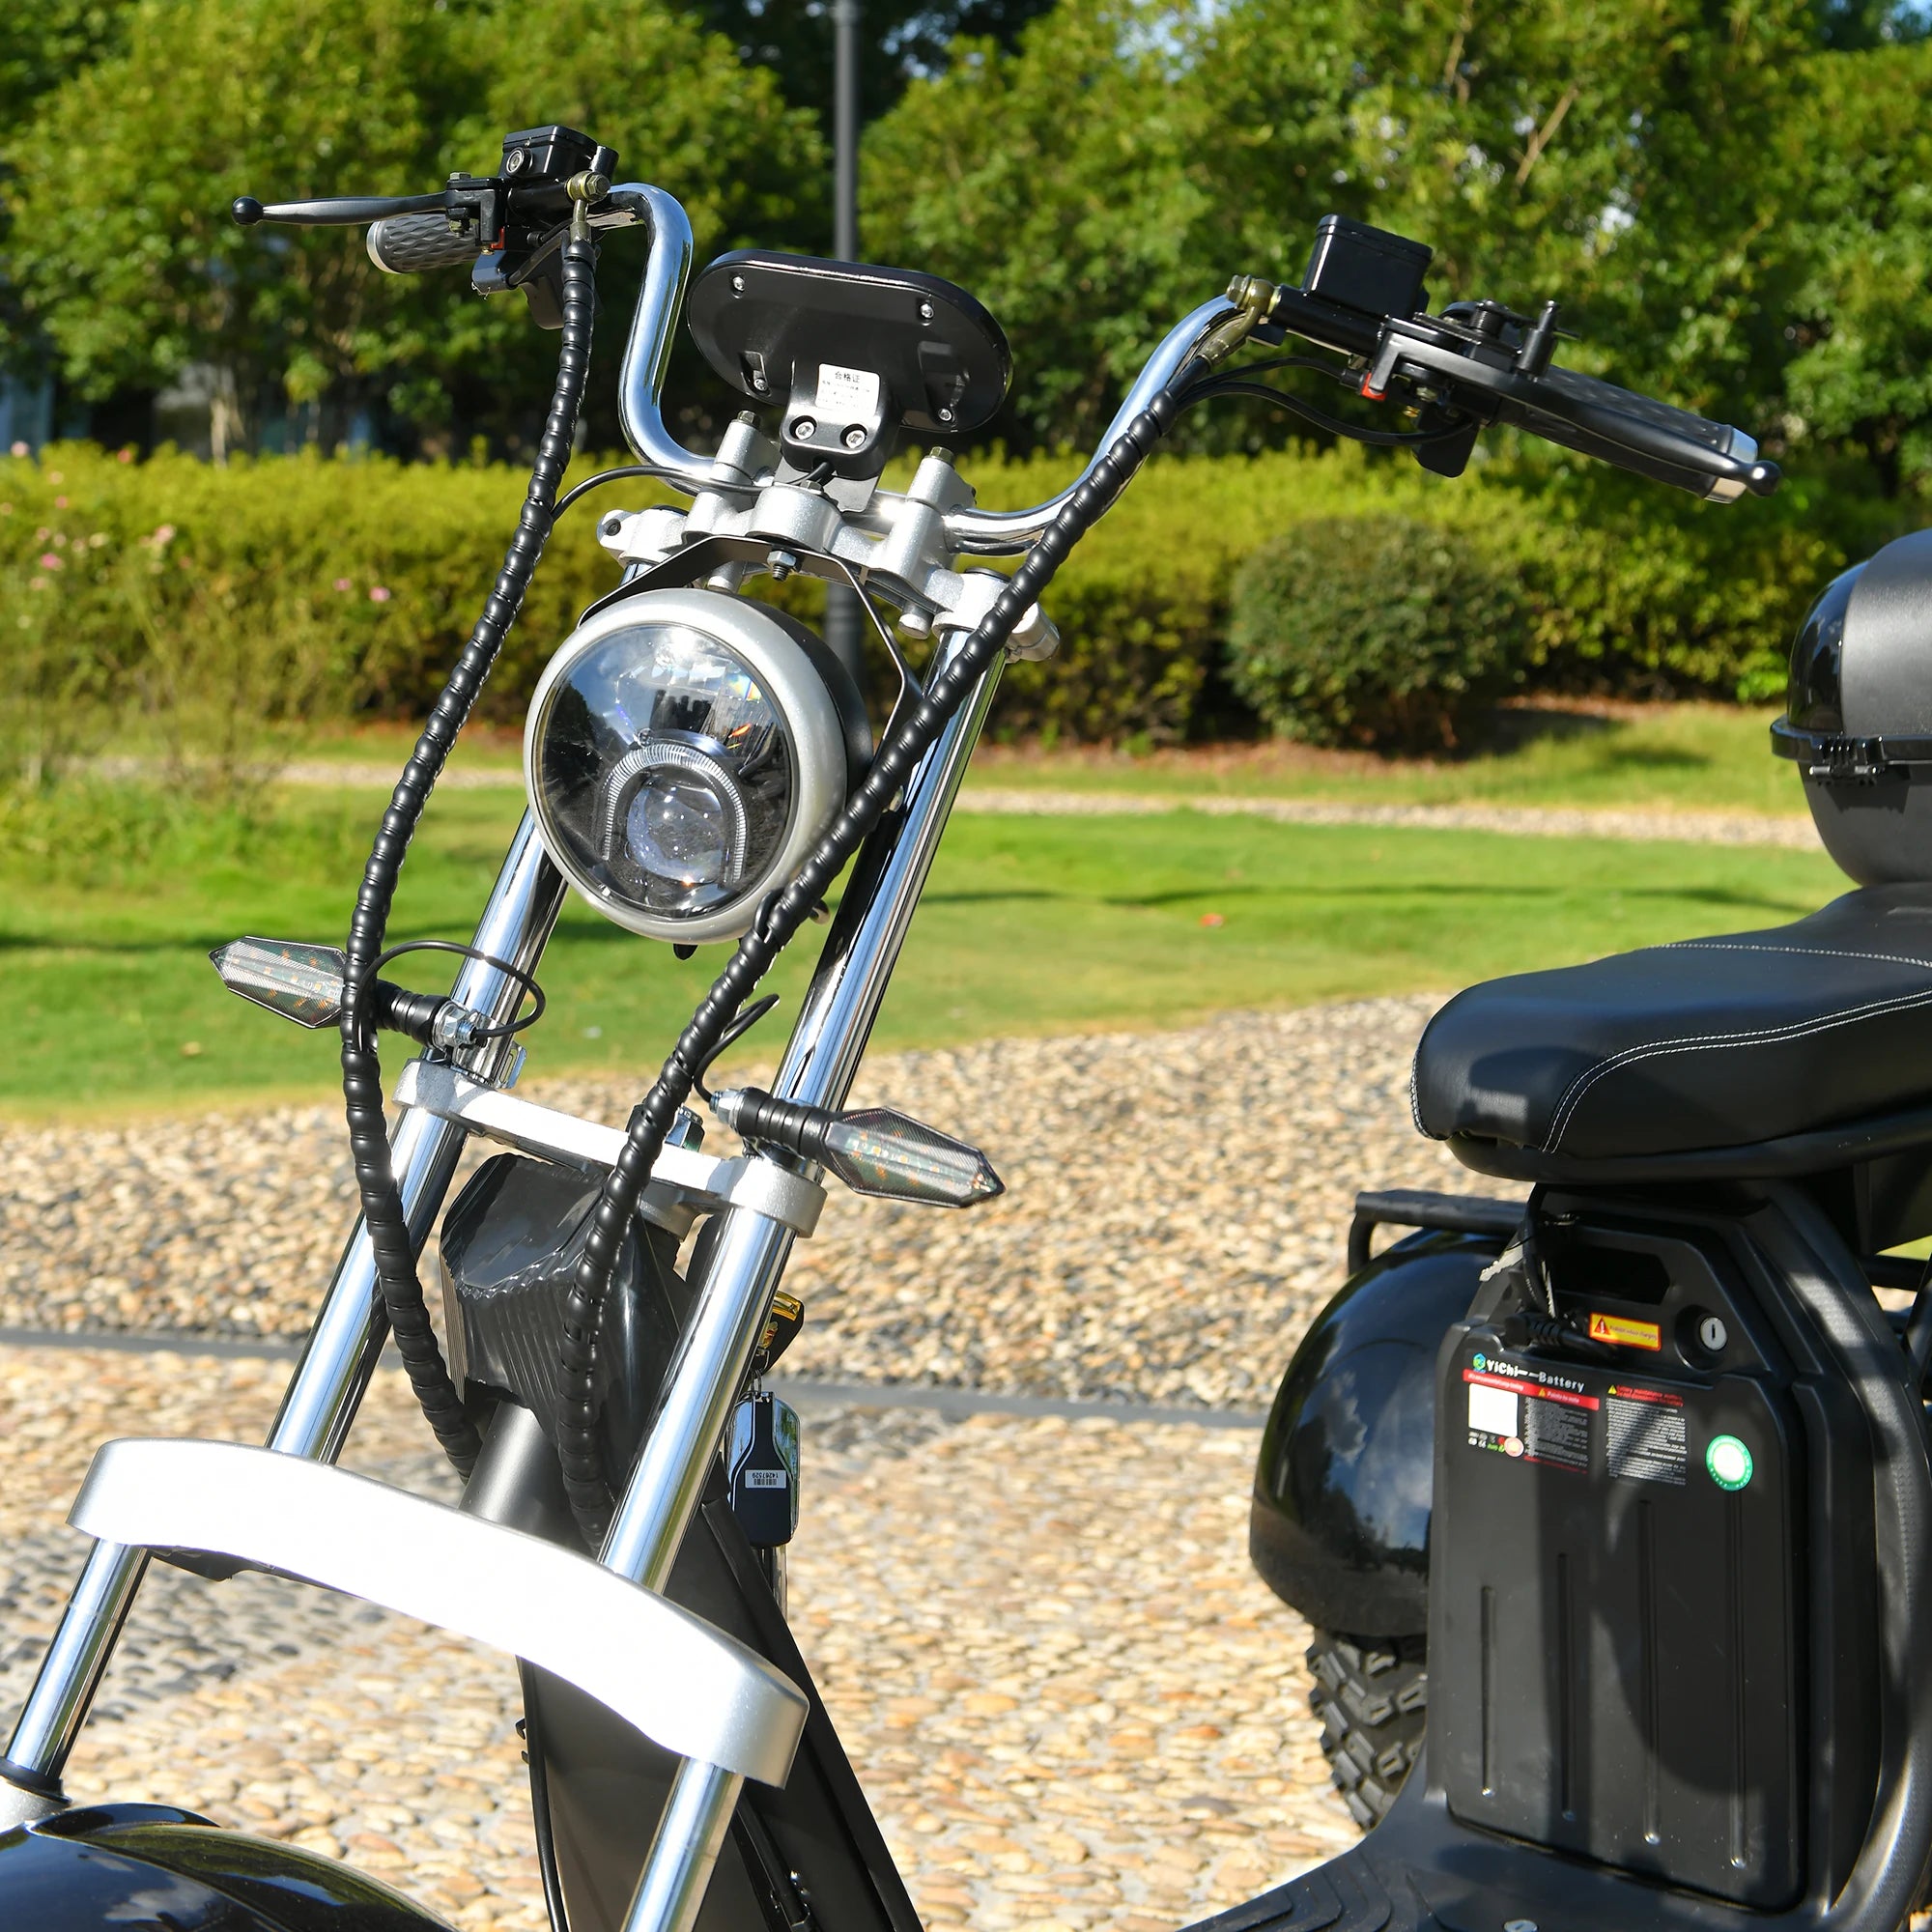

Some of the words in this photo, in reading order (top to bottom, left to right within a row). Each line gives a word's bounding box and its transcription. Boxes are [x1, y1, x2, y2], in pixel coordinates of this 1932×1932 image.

[835, 371, 860, 384] 合格证
[1539, 1372, 1585, 1393] Battery
